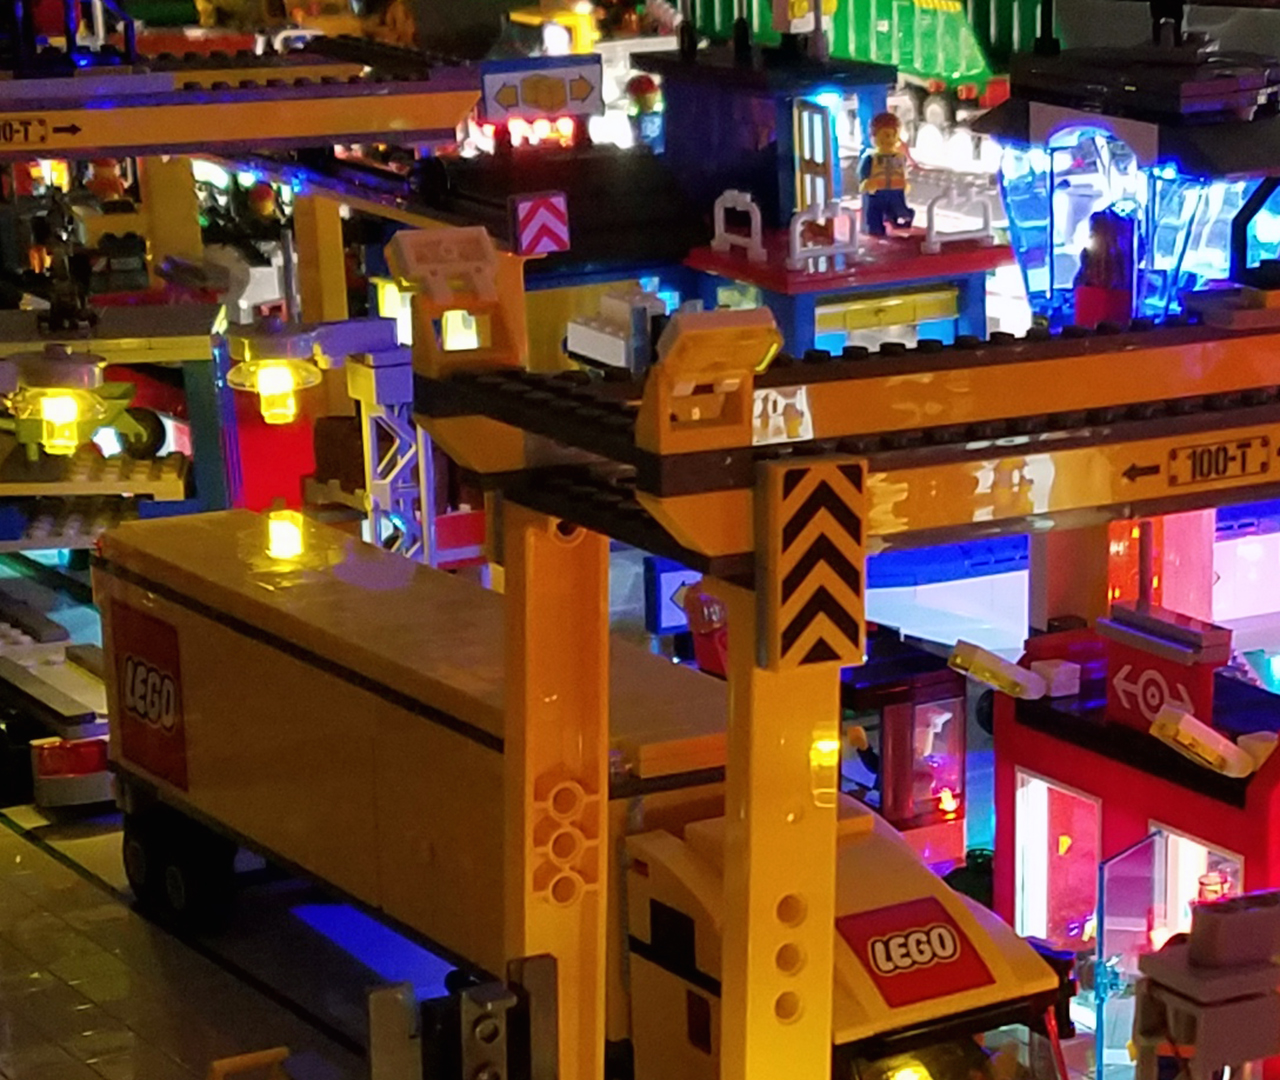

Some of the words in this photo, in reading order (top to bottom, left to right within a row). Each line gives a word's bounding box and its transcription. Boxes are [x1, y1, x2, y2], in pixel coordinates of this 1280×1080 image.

[1188, 442, 1251, 481] 100-T
[124, 658, 176, 731] LEGO
[871, 925, 957, 973] LEGO
